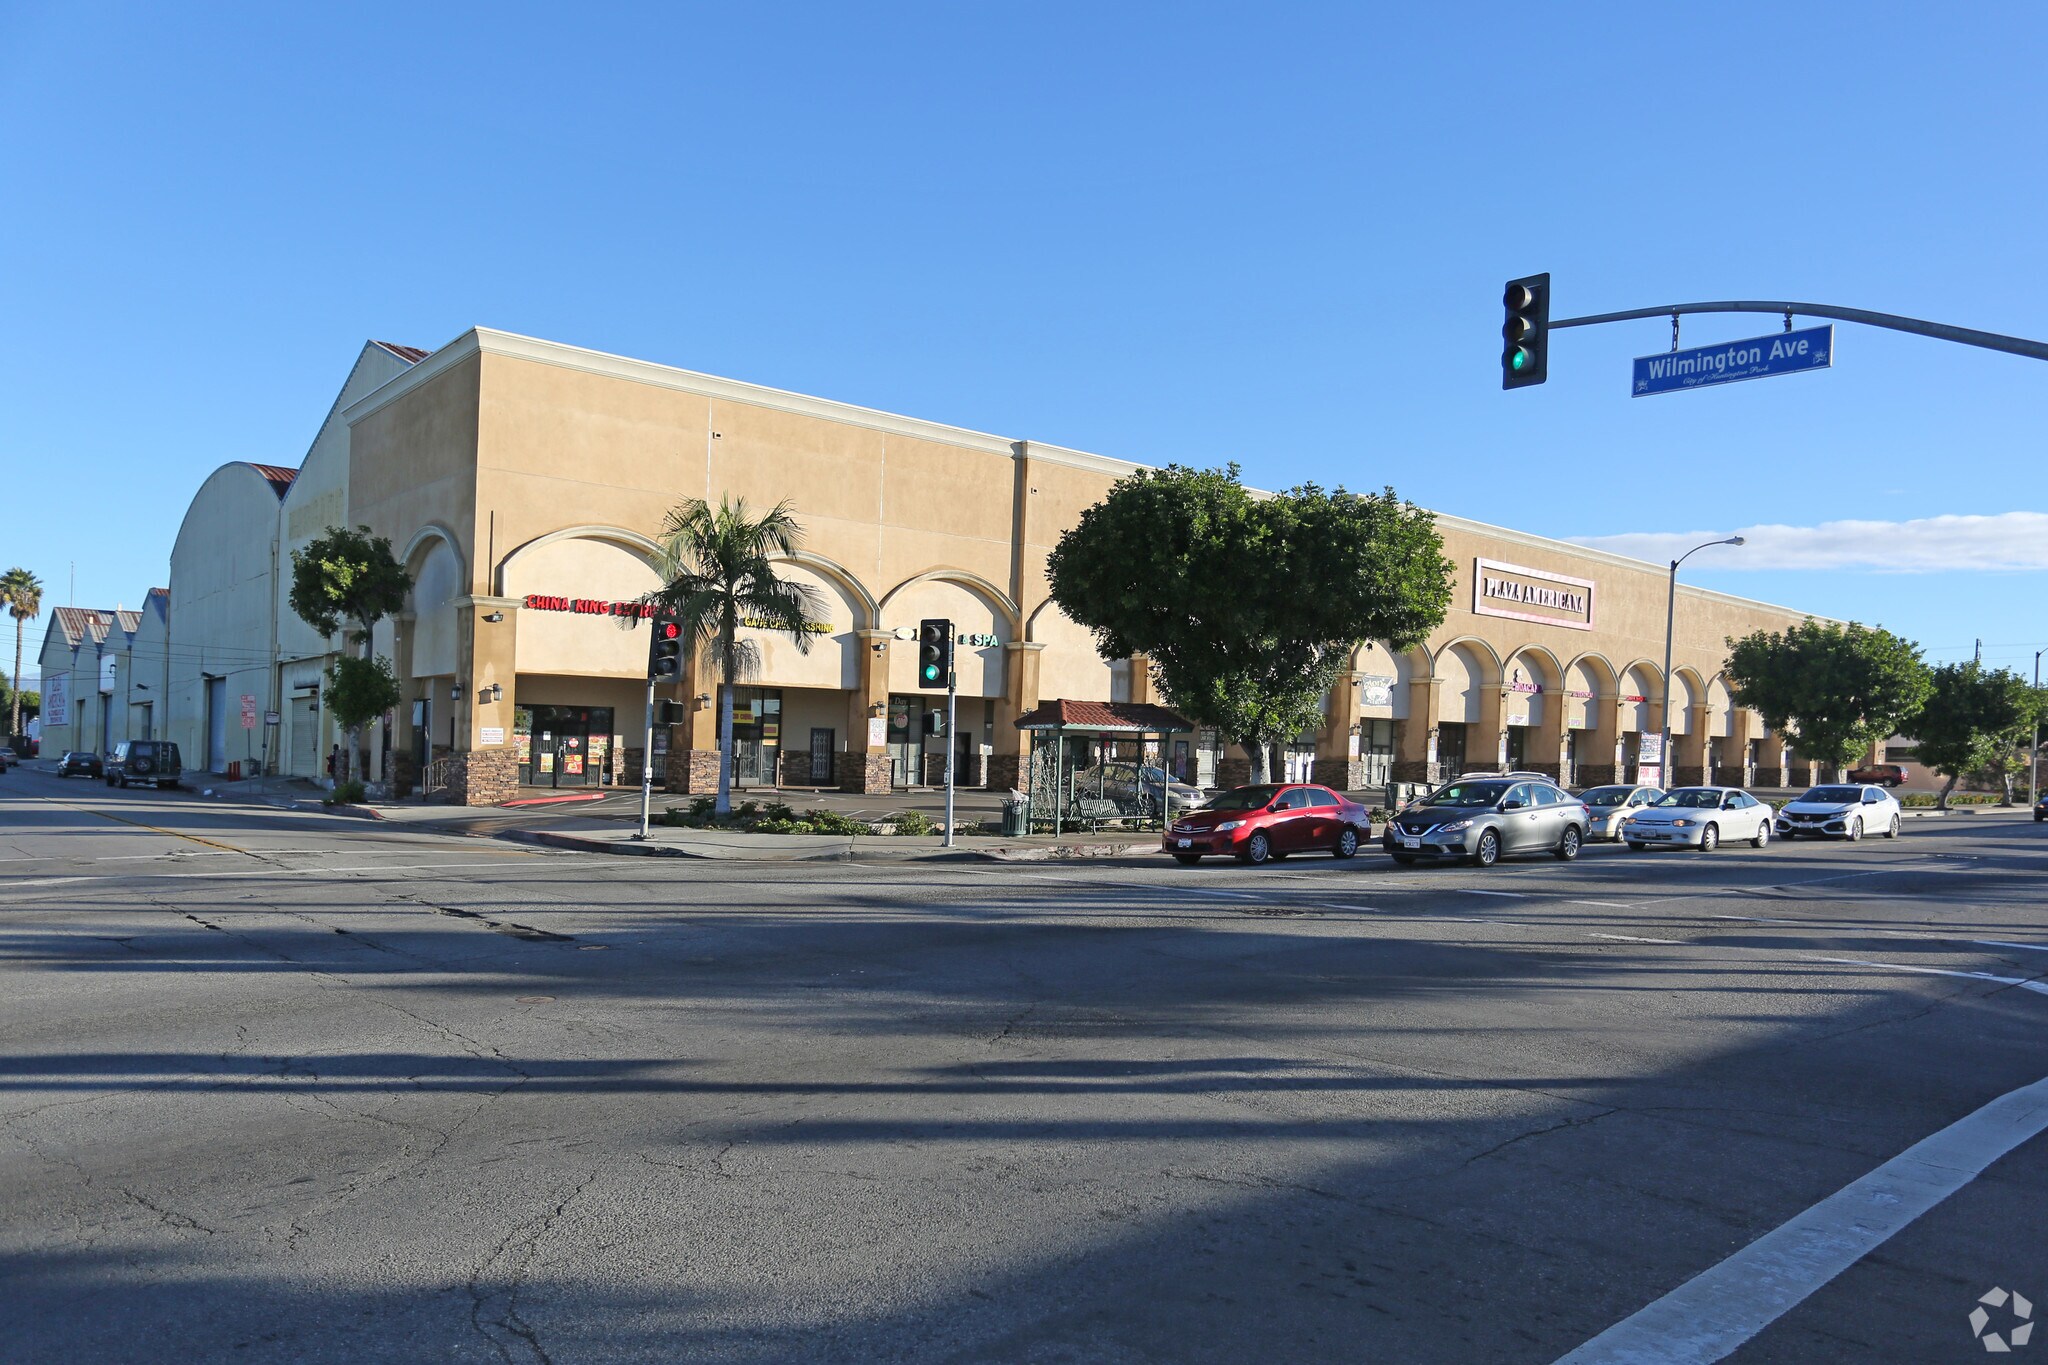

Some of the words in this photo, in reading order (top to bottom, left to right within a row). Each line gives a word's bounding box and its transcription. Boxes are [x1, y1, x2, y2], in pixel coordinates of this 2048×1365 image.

[1648, 347, 1760, 380] Wilmington
[1769, 339, 1809, 361] Ave
[1683, 376, 1698, 385] City
[1698, 375, 1706, 385] of
[1707, 369, 1749, 381] Huntington
[1750, 366, 1769, 375] Park
[527, 594, 570, 611] CHINA
[576, 598, 610, 615] KING
[1485, 577, 1522, 602] PLAZA
[1524, 585, 1584, 613] AMERICANA
[974, 633, 998, 647] SPA
